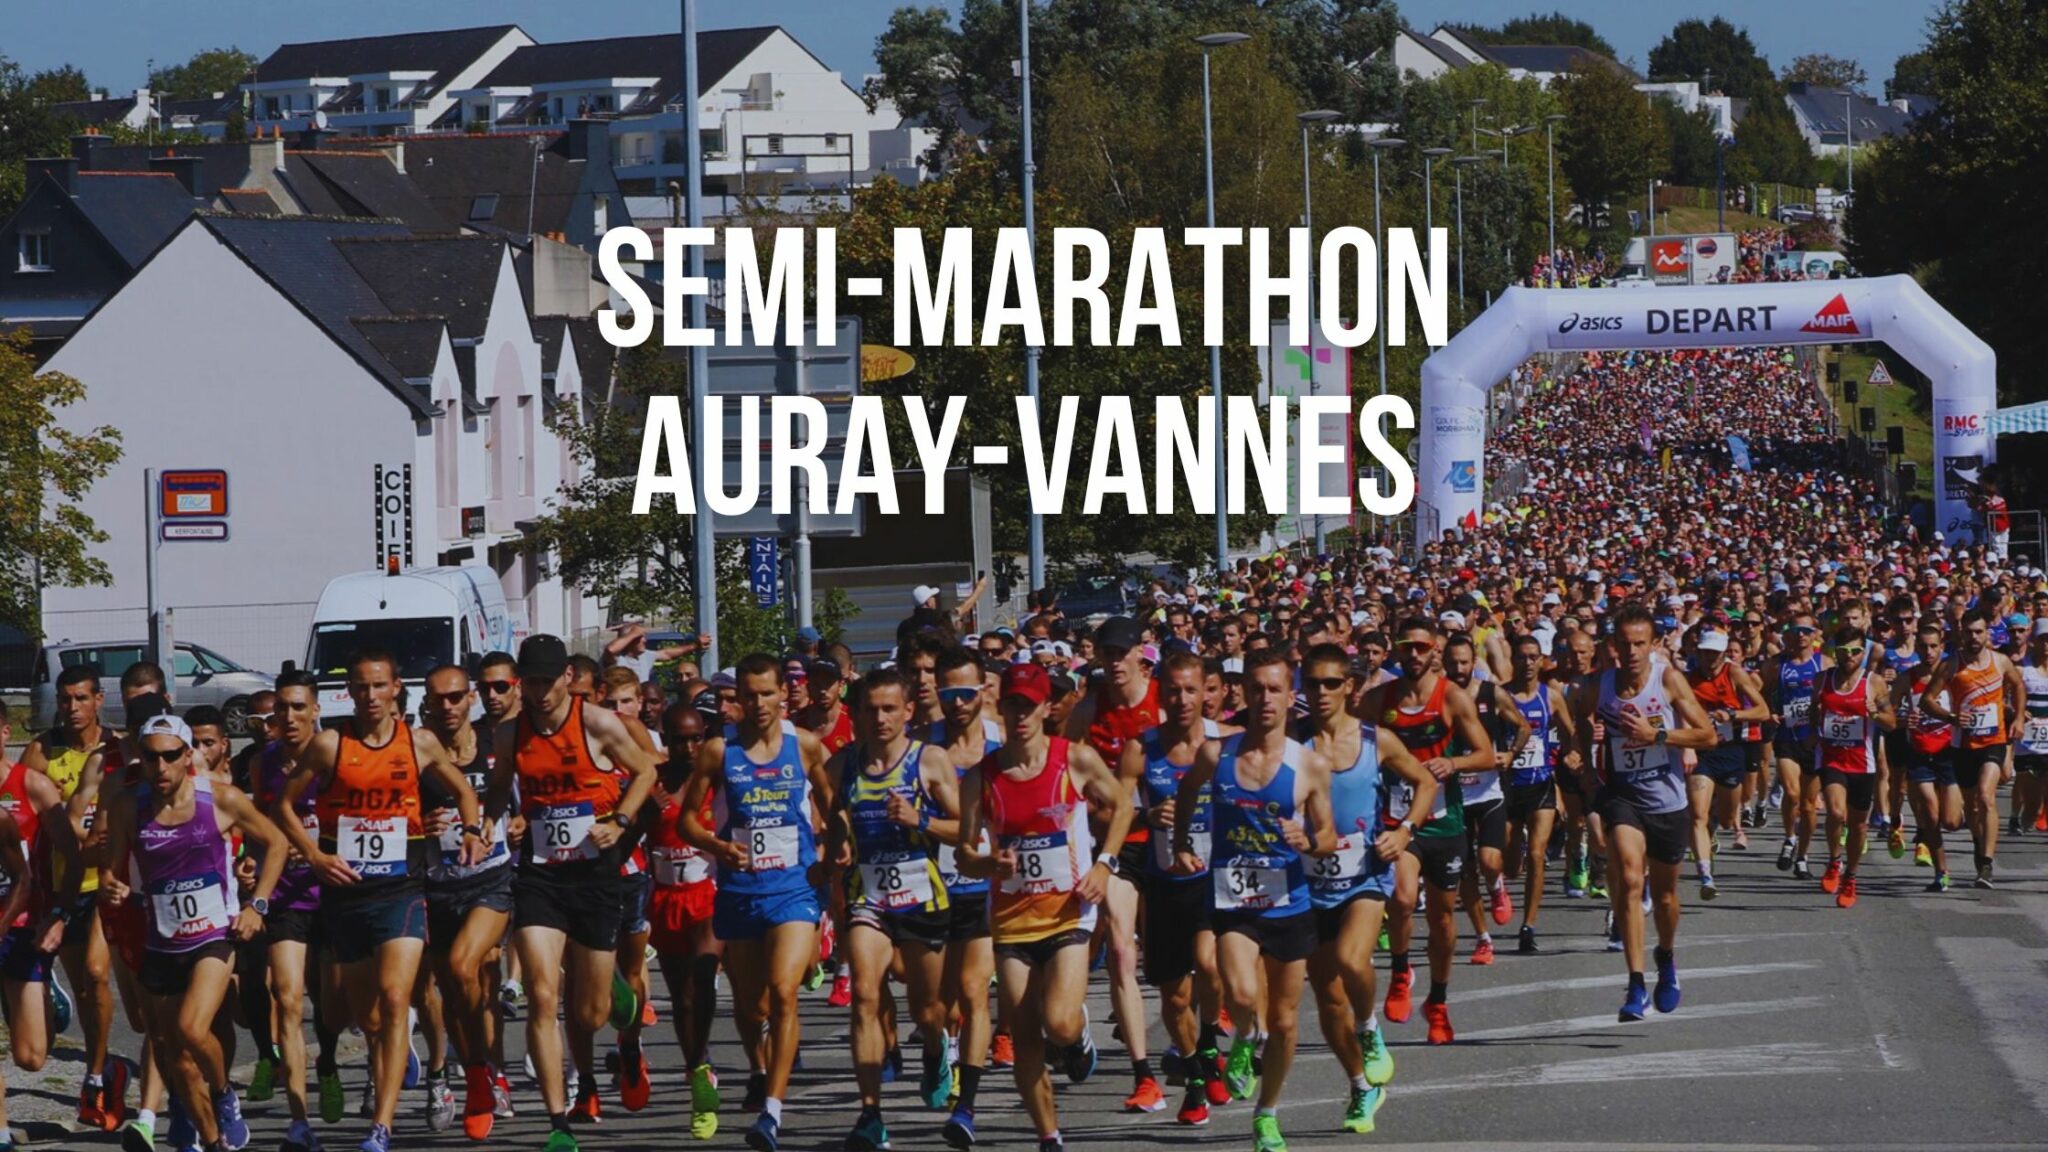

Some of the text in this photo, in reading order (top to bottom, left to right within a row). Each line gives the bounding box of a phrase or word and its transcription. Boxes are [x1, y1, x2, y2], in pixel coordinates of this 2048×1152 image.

[1579, 315, 1623, 331] asics
[1647, 305, 1777, 335] DEPART
[1809, 312, 1852, 329] MAIF
[1944, 415, 1978, 430] RMC
[1954, 428, 1985, 437] SPORT
[754, 537, 773, 604] NTAINE
[1832, 724, 1850, 739] 95
[2032, 726, 2048, 740] 79
[1623, 748, 1647, 770] 37
[543, 821, 571, 846] 26
[753, 831, 766, 855] 8
[354, 833, 385, 859] 19
[365, 863, 392, 875] asics
[672, 861, 688, 881] 7
[1312, 853, 1342, 877] 33
[177, 878, 204, 891] asics
[874, 866, 903, 891] 28
[1231, 869, 1260, 895] 34
[169, 894, 198, 920] 10
